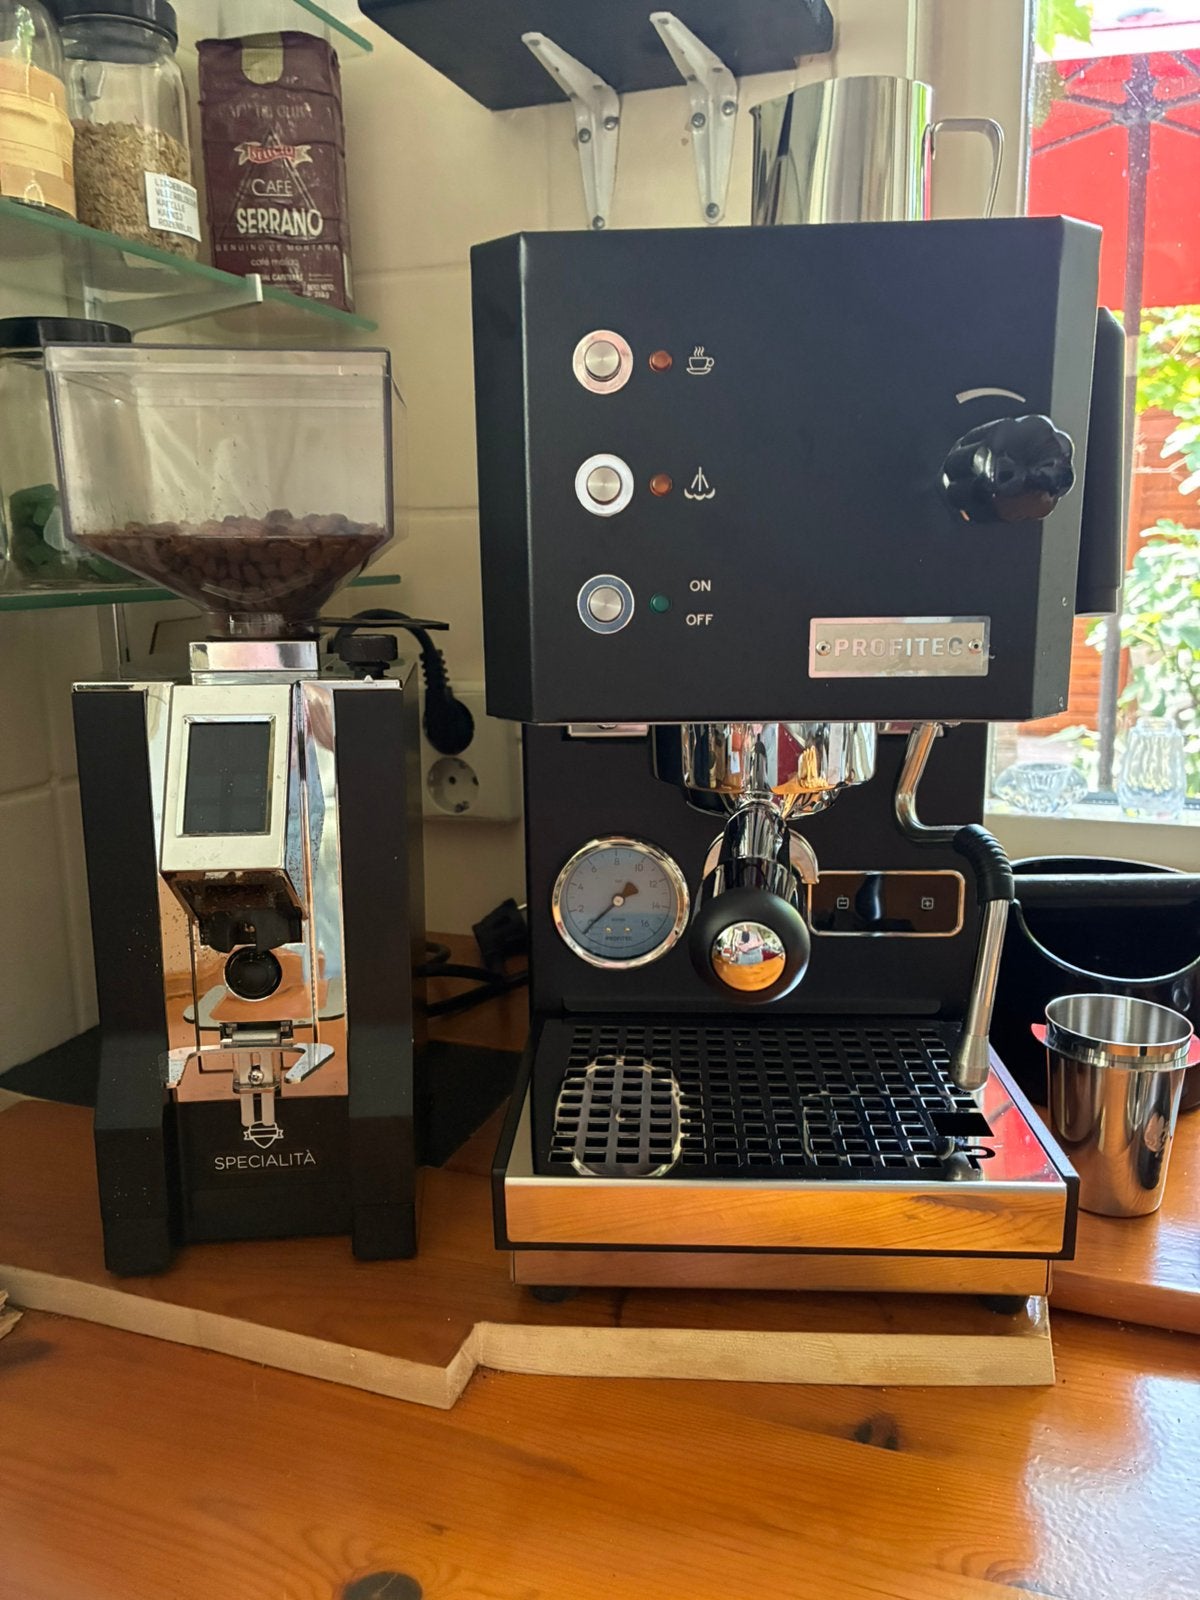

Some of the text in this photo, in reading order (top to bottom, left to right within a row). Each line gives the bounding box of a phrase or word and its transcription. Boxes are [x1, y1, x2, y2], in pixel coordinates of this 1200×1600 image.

[251, 178, 293, 196] CAFE
[236, 207, 324, 237] SERRANO
[690, 580, 711, 592] ON
[686, 614, 713, 626] OFF
[834, 637, 963, 657] PROFITEC
[613, 858, 620, 866] 8
[635, 864, 644, 873] 10
[577, 882, 584, 890] 4
[649, 880, 658, 888] 12
[577, 904, 584, 913] 2
[652, 901, 661, 909] 14
[641, 919, 650, 928] 16
[214, 1149, 317, 1170] SPECIALITÀ
